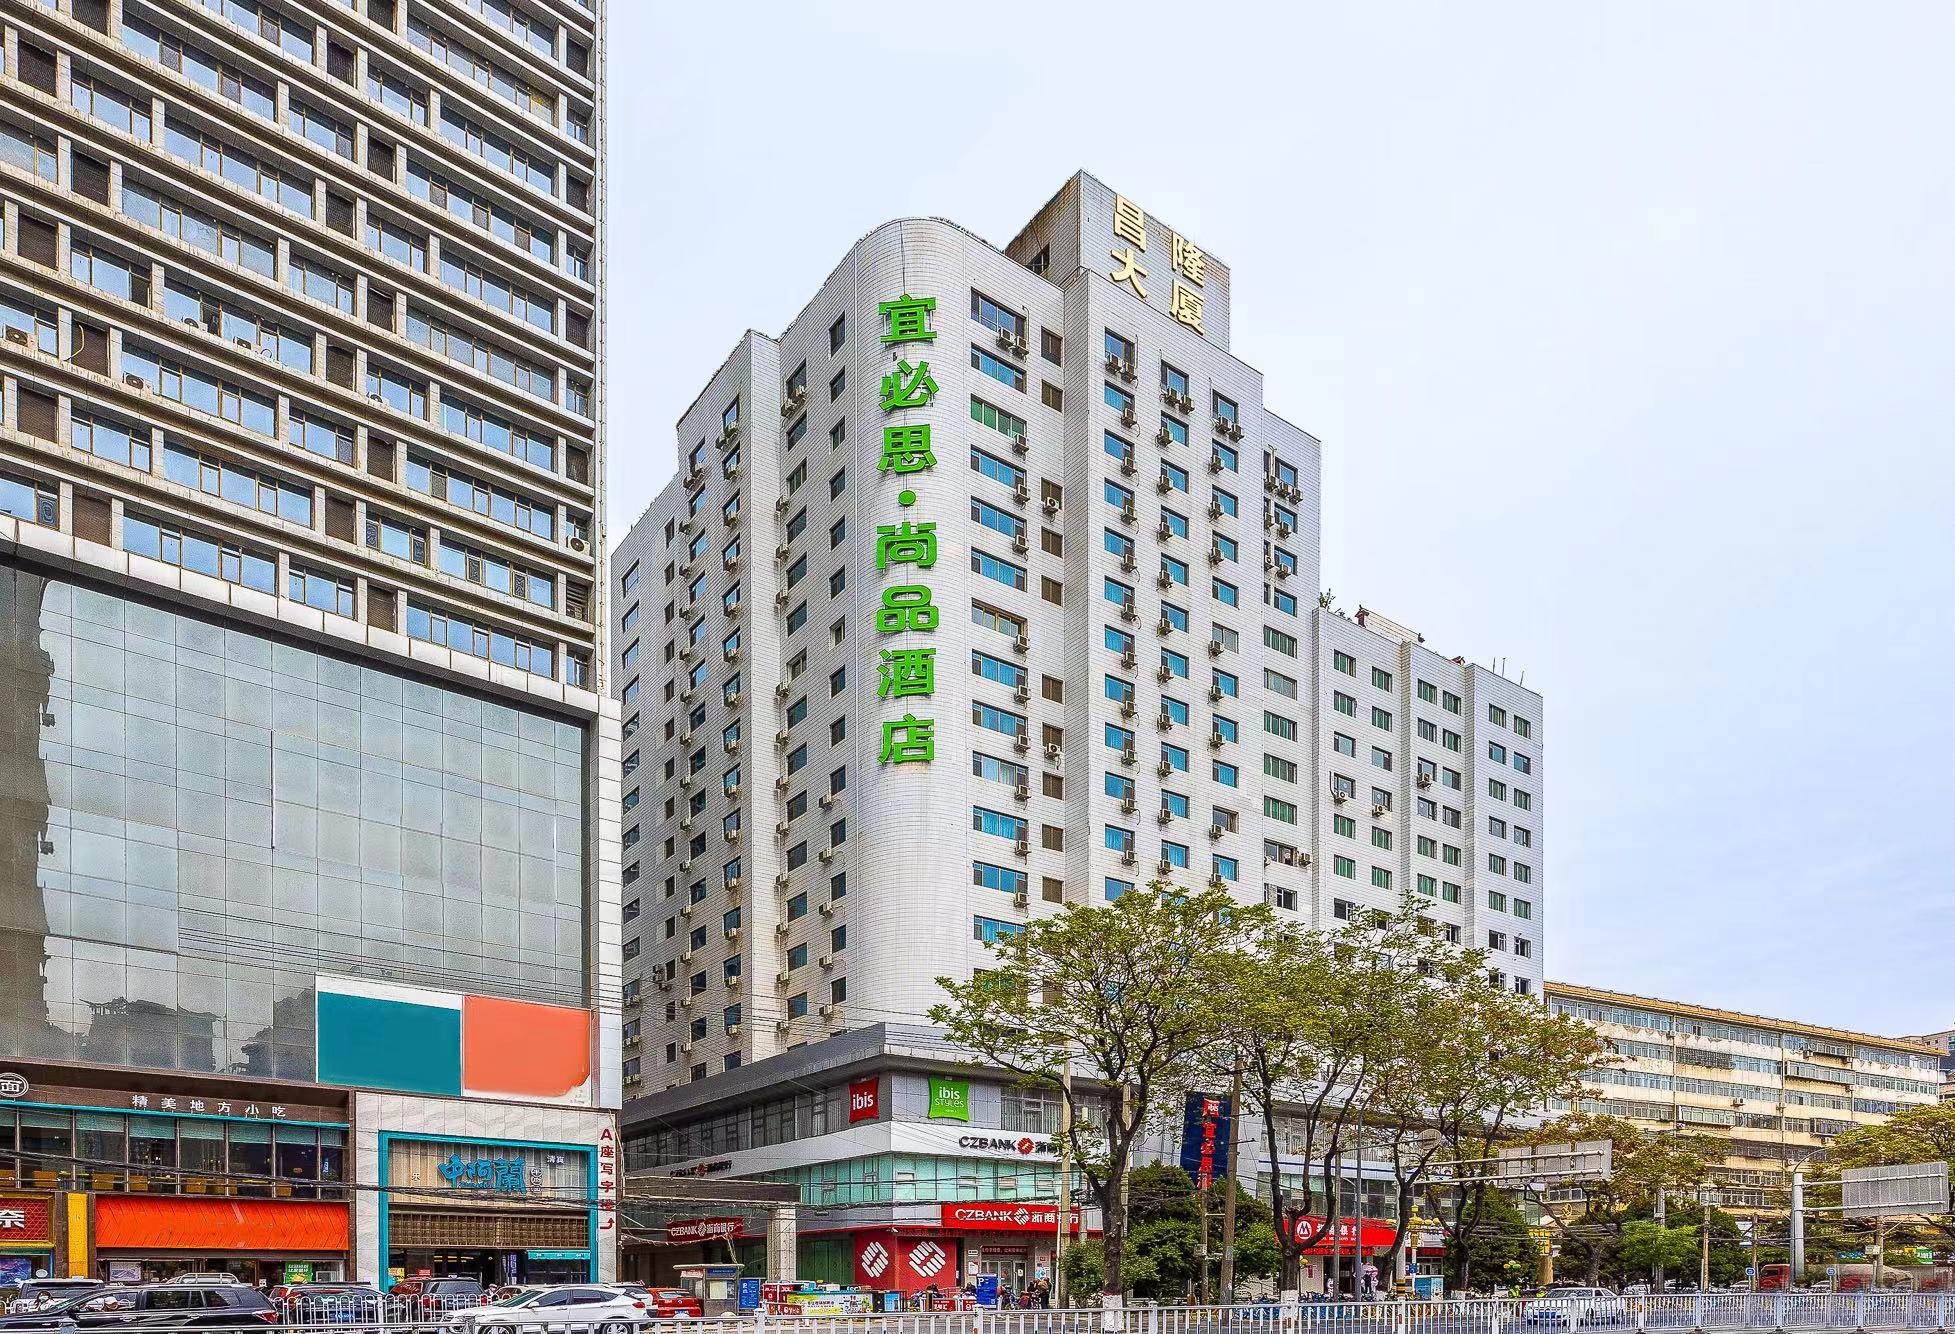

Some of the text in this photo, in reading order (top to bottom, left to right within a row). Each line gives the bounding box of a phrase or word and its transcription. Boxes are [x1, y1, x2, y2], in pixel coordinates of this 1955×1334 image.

[1109, 247, 1206, 336] 大厦
[852, 1091, 874, 1110] ibis
[939, 1086, 961, 1100] ibis
[131, 1094, 286, 1117] 精美地方小吃
[958, 1135, 1017, 1151] CZBANK
[955, 1208, 1080, 1225] CZBANK 浙商行
